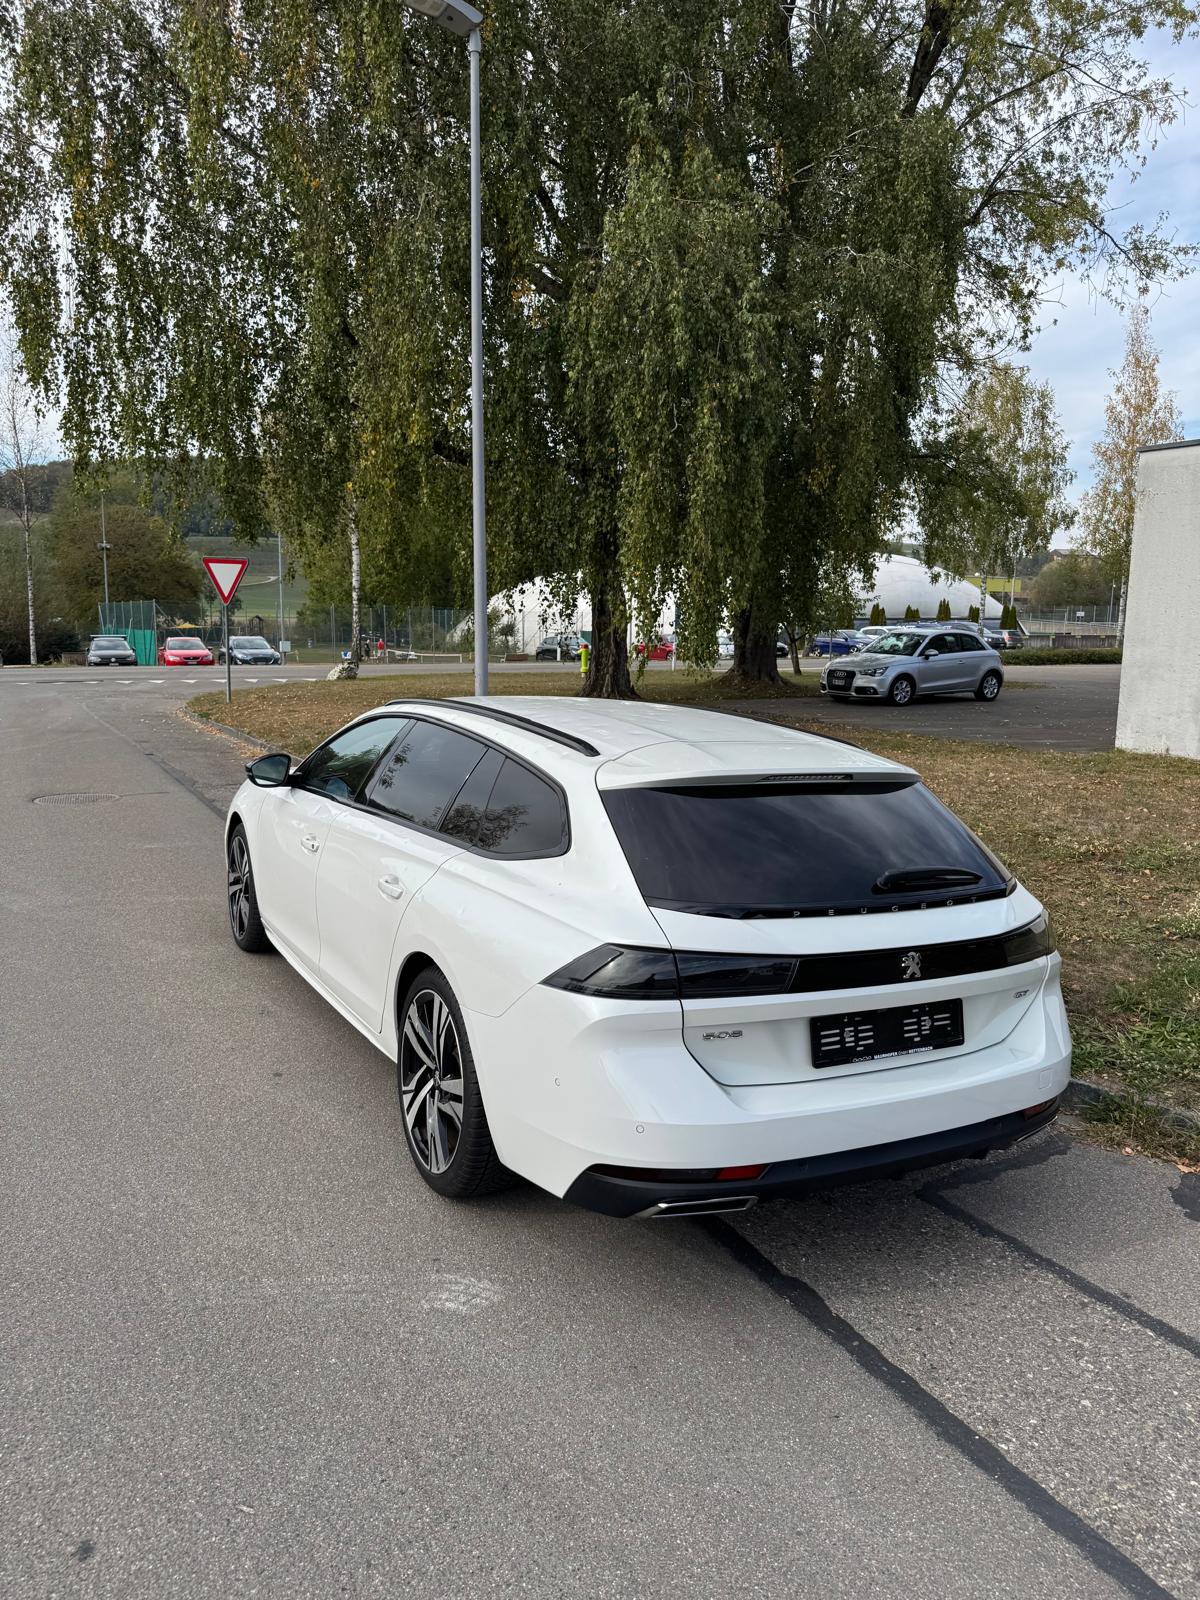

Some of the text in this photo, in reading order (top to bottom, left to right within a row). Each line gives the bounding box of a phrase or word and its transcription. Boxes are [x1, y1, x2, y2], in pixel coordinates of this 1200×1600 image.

[793, 896, 977, 918] PEUGEOT
[1014, 989, 1030, 999] GT
[702, 1030, 743, 1040] 508
